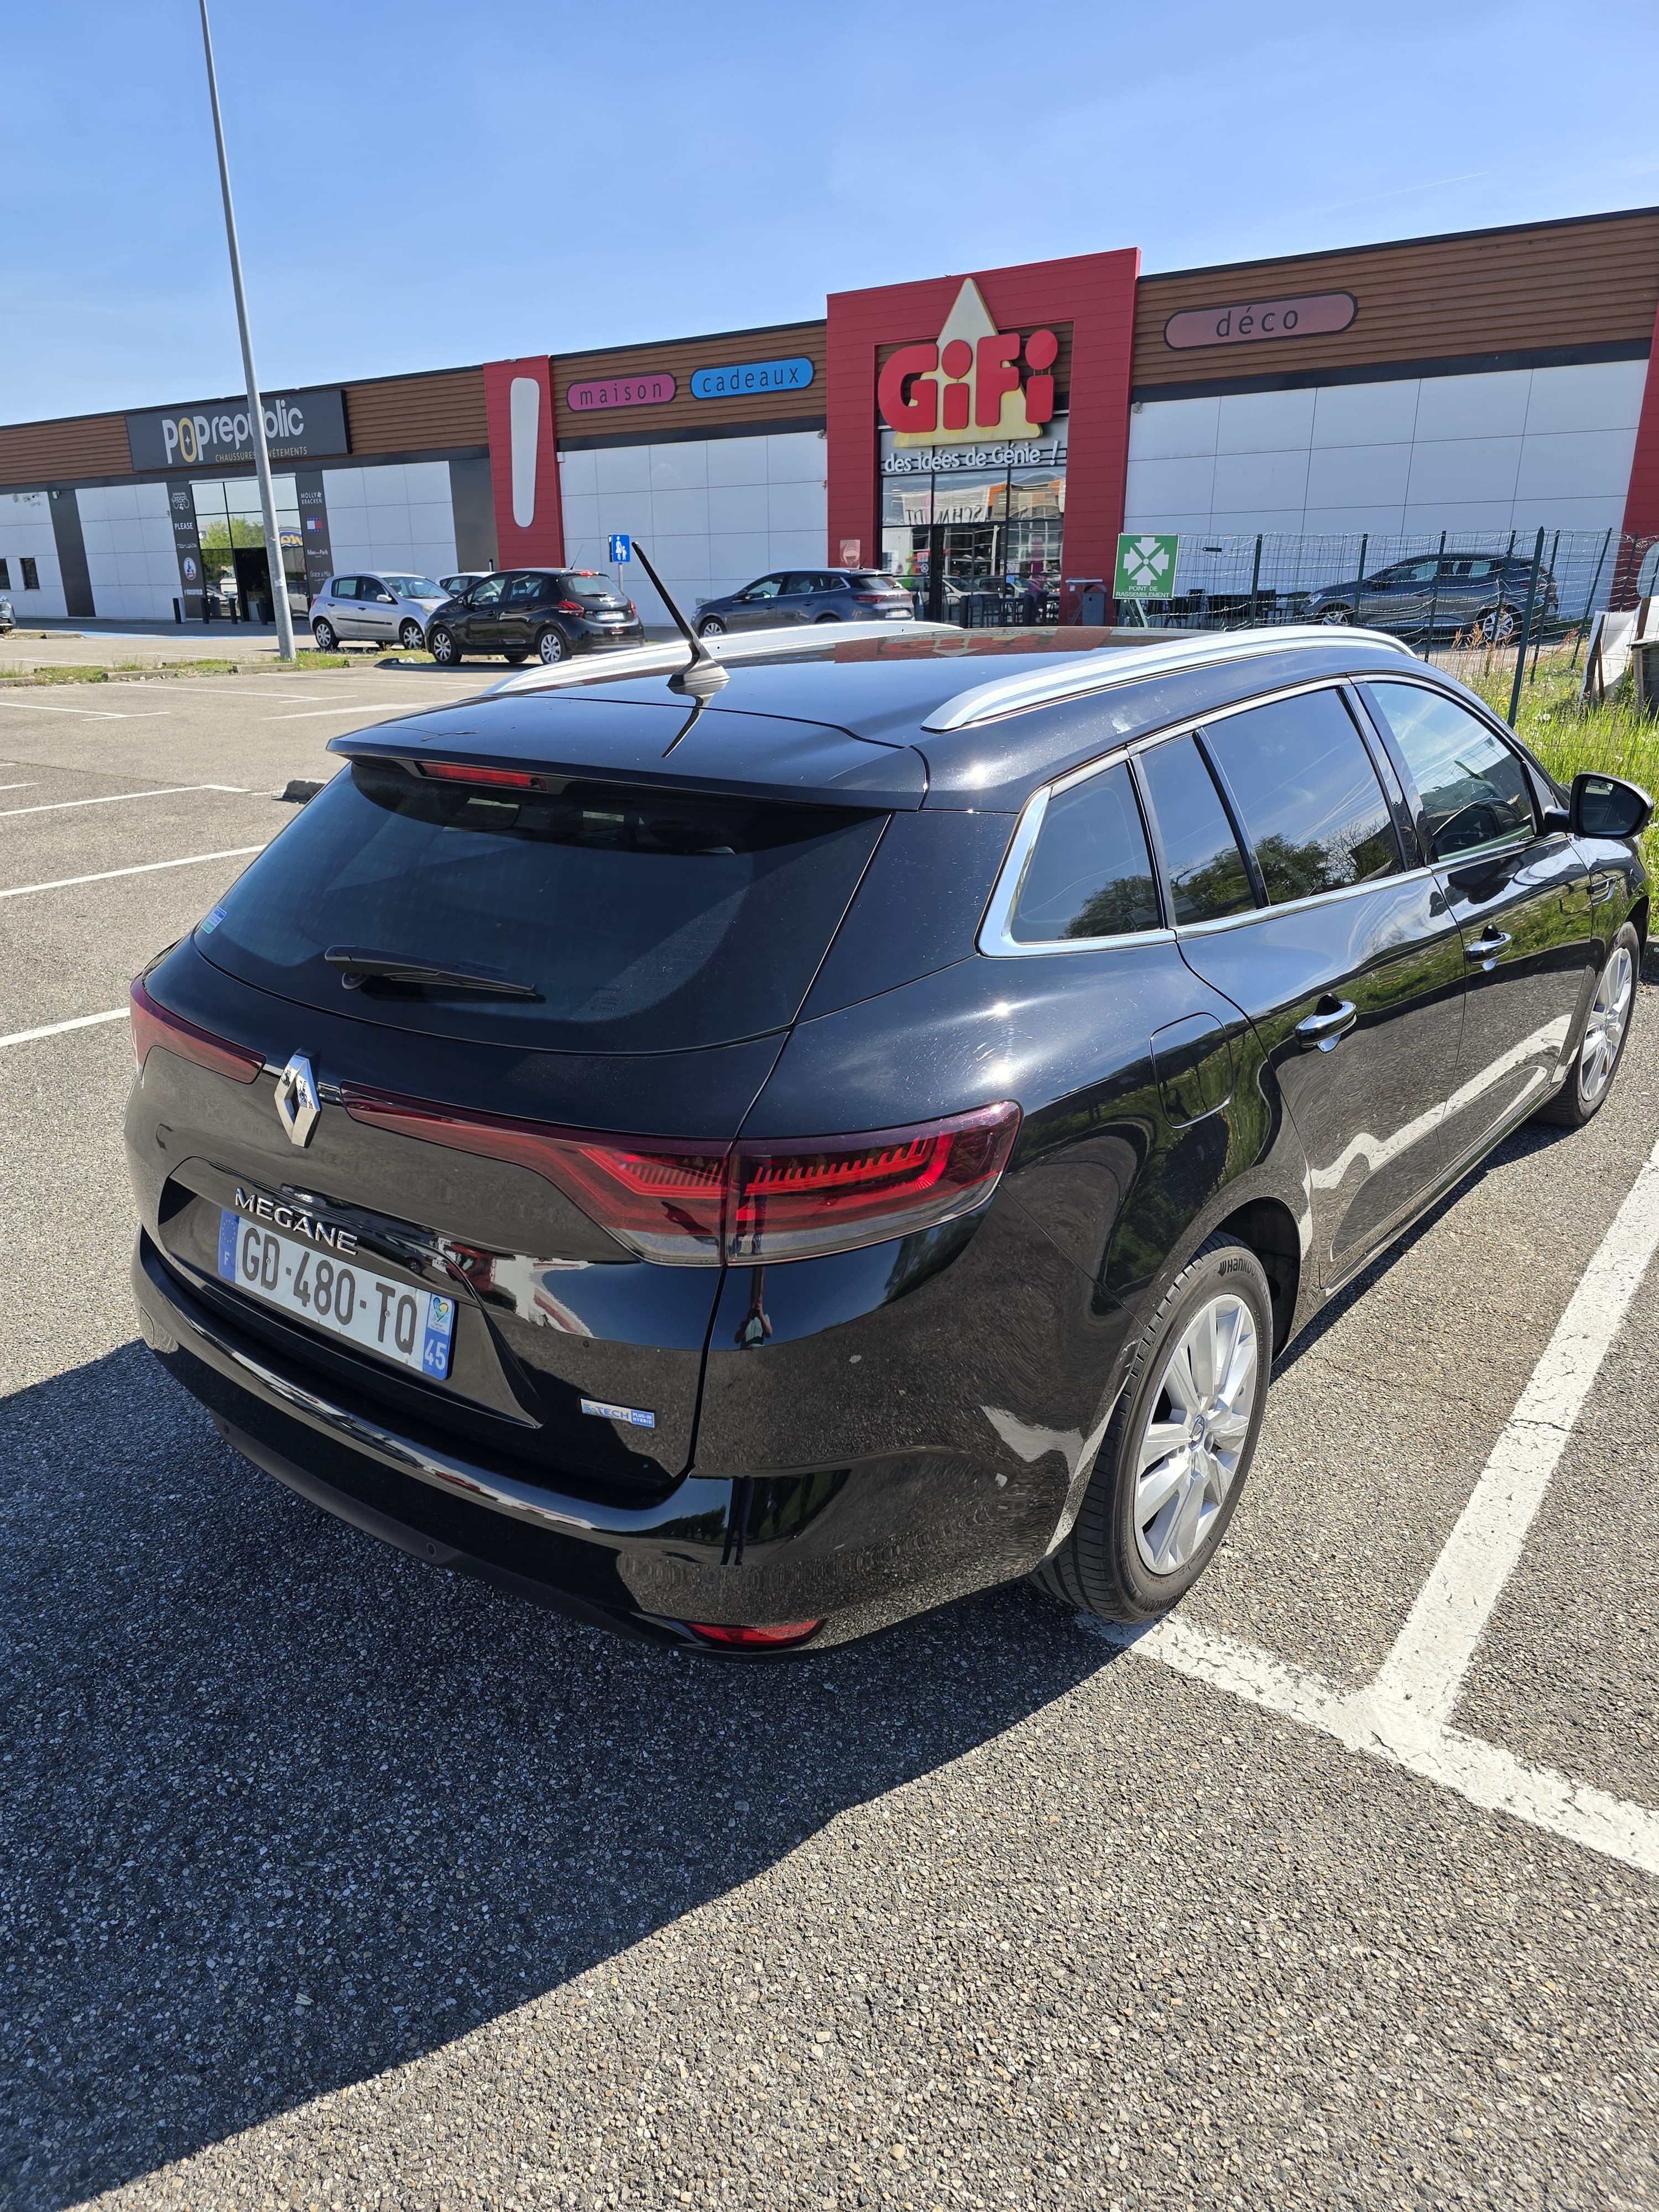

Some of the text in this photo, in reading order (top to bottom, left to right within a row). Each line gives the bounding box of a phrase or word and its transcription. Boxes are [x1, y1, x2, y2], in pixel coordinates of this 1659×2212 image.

[1216, 306, 1298, 337] déco
[703, 367, 799, 393] cadeaux
[580, 382, 661, 405] maison
[215, 446, 307, 462] CHAUSSURES VÊTEMENTS
[885, 453, 912, 472] des
[918, 450, 959, 471] idées
[966, 446, 987, 466] de
[992, 442, 1041, 465] Génie
[174, 522, 193, 530] PLEASE
[235, 1187, 358, 1256] MEGANE
[224, 1253, 230, 1266] F
[424, 1338, 447, 1370] 45
[583, 1404, 629, 1420] E-TECH
